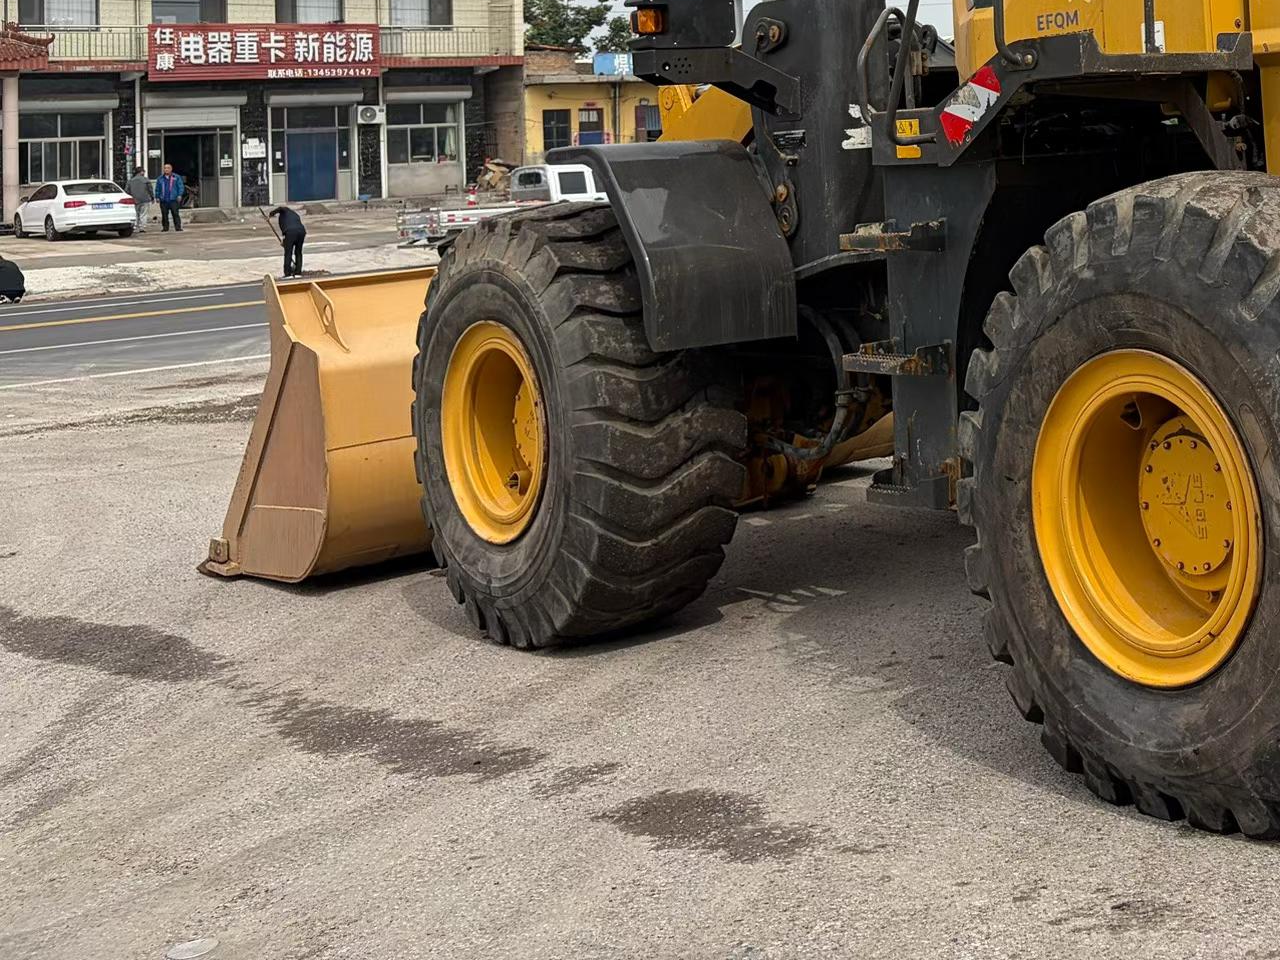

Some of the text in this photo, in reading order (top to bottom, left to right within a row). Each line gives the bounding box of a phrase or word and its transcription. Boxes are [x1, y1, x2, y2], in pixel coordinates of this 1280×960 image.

[1036, 9, 1080, 32] EFQM
[154, 27, 176, 71] 任康
[180, 31, 374, 65] 电器重卡 新能源
